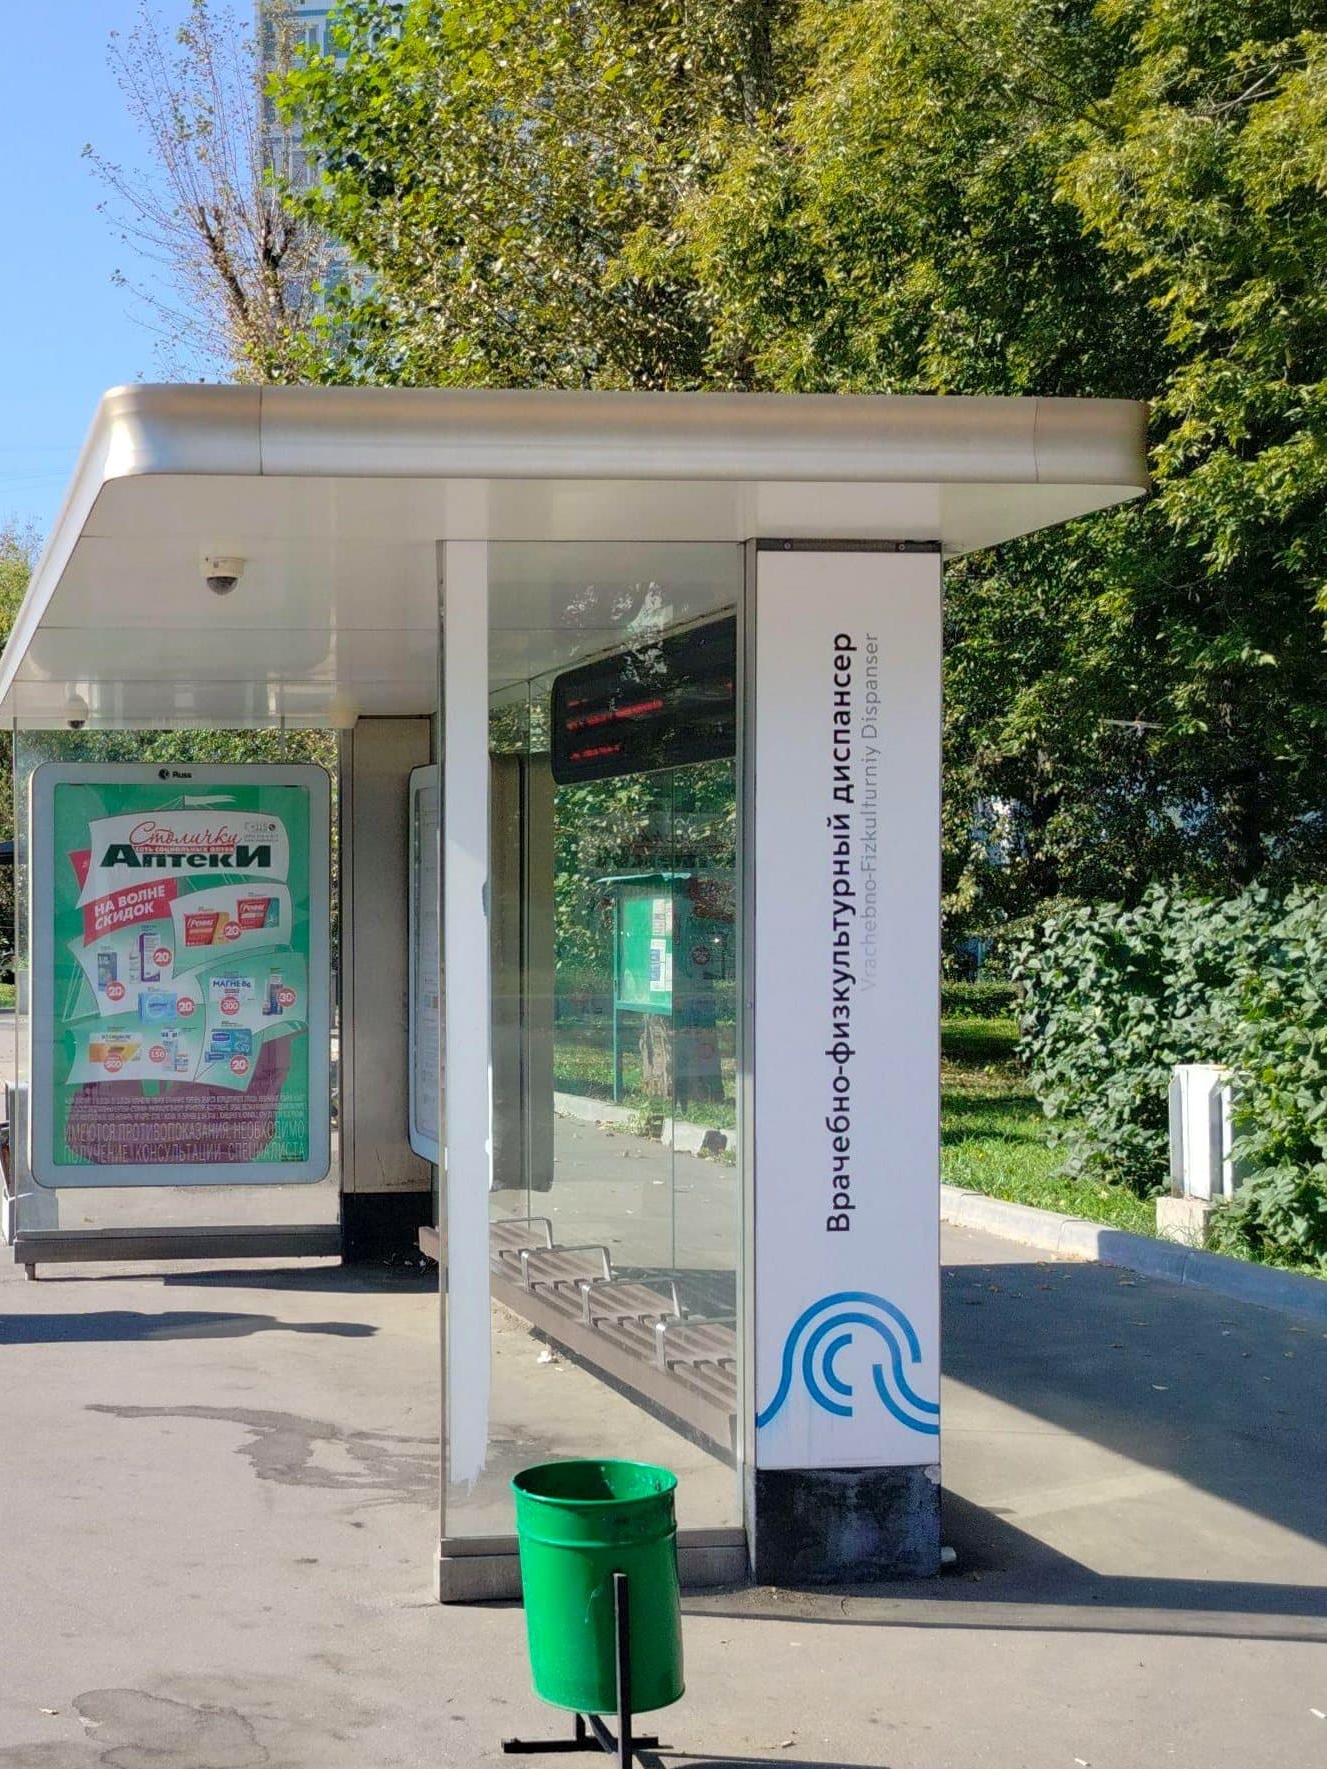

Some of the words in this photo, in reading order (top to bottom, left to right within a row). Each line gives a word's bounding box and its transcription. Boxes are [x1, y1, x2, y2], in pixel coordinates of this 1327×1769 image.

[861, 632, 881, 740] Dispanser
[833, 632, 857, 804] диспансер
[129, 821, 242, 846] Столички
[860, 744, 881, 992] Vrachebno-Fizkulturniy
[94, 900, 115, 917] НА
[118, 885, 165, 908] ВОЛНЕ
[95, 902, 154, 930] СКИДОК
[824, 813, 856, 1232] Врачебно-физкультурный
[233, 1119, 305, 1140] НЕОБХОДИМО
[135, 1142, 221, 1163] КОНСУЛЬТАЦИИ
